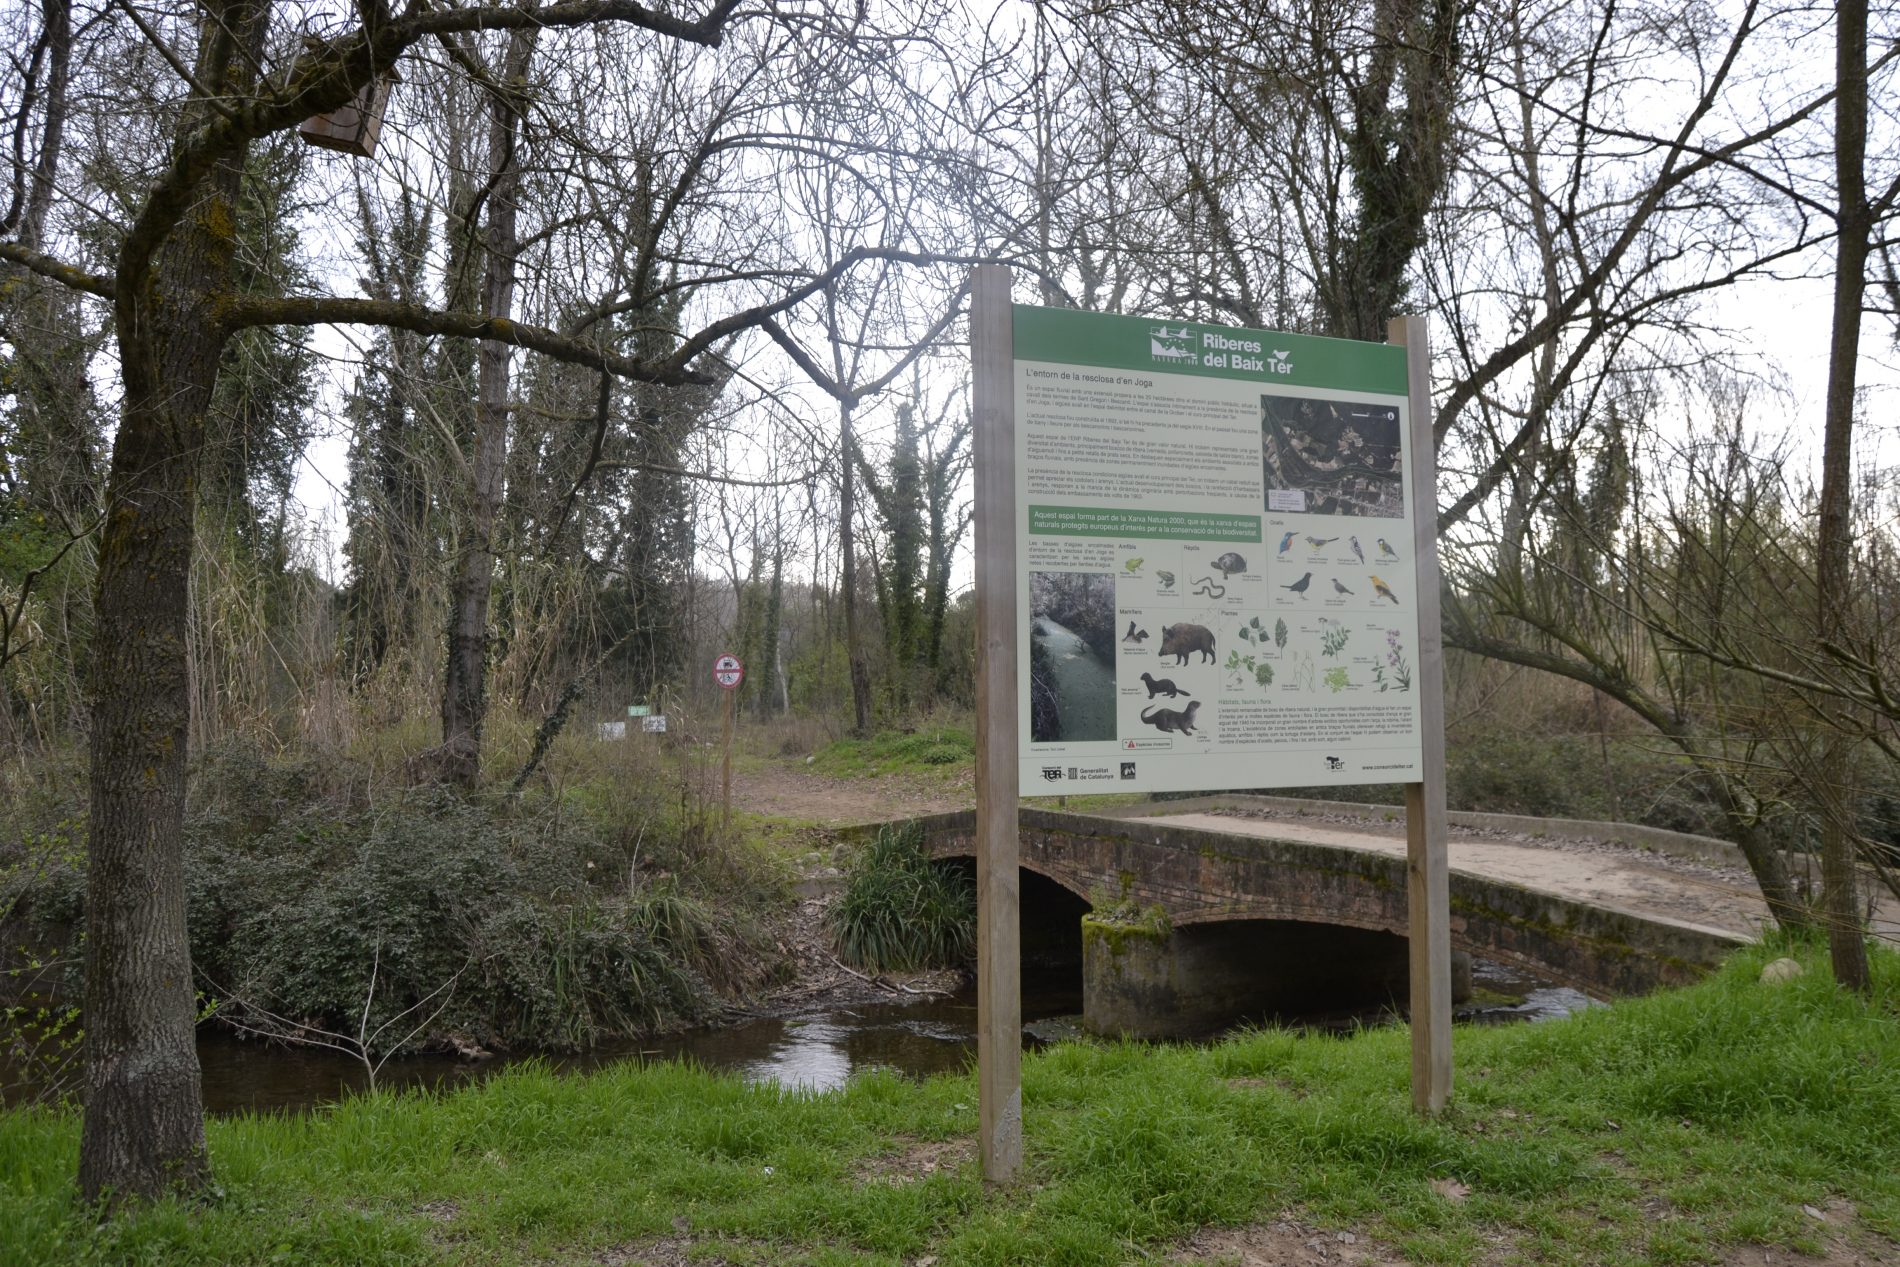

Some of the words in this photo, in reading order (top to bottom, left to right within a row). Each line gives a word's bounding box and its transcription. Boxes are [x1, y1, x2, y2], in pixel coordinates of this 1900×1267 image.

[1204, 333, 1261, 353] Riberes
[1204, 352, 1226, 368] del
[1232, 355, 1264, 372] Baix
[1267, 358, 1293, 375] Ter
[1026, 369, 1058, 379] L'entorn
[1060, 372, 1070, 380] de
[1072, 373, 1079, 381] la
[1081, 374, 1114, 384] resclosa
[1116, 377, 1132, 386] d'en
[1134, 378, 1152, 389] Joga
[1035, 511, 1057, 520] Aquest
[1058, 512, 1076, 521] espai
[1097, 514, 1109, 522] part
[1128, 515, 1146, 523] Xarxa
[1148, 516, 1168, 524] Natura
[1061, 521, 1088, 530] protegits
[1171, 526, 1205, 534] conservació
